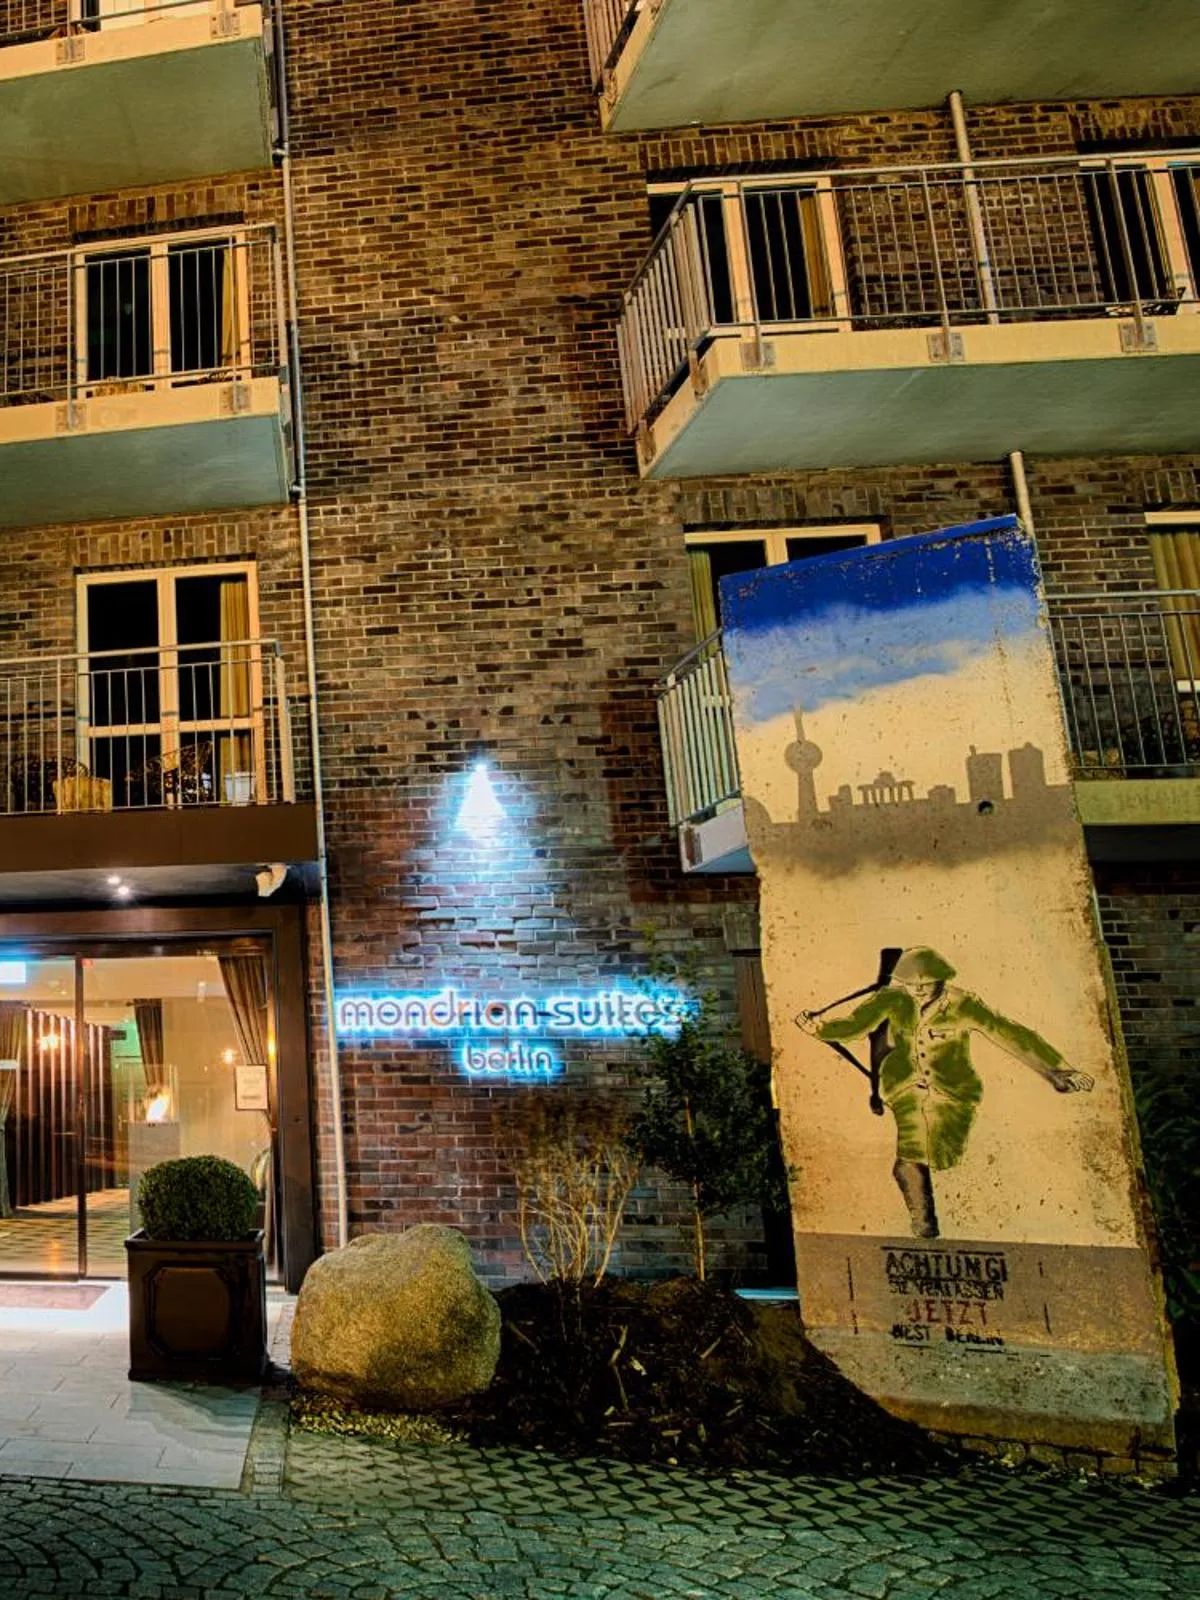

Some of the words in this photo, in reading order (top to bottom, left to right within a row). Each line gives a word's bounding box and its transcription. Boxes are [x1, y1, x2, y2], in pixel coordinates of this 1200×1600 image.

[341, 990, 538, 1026] mondrian
[466, 1044, 553, 1072] berlin
[906, 1300, 988, 1325] JETZT
